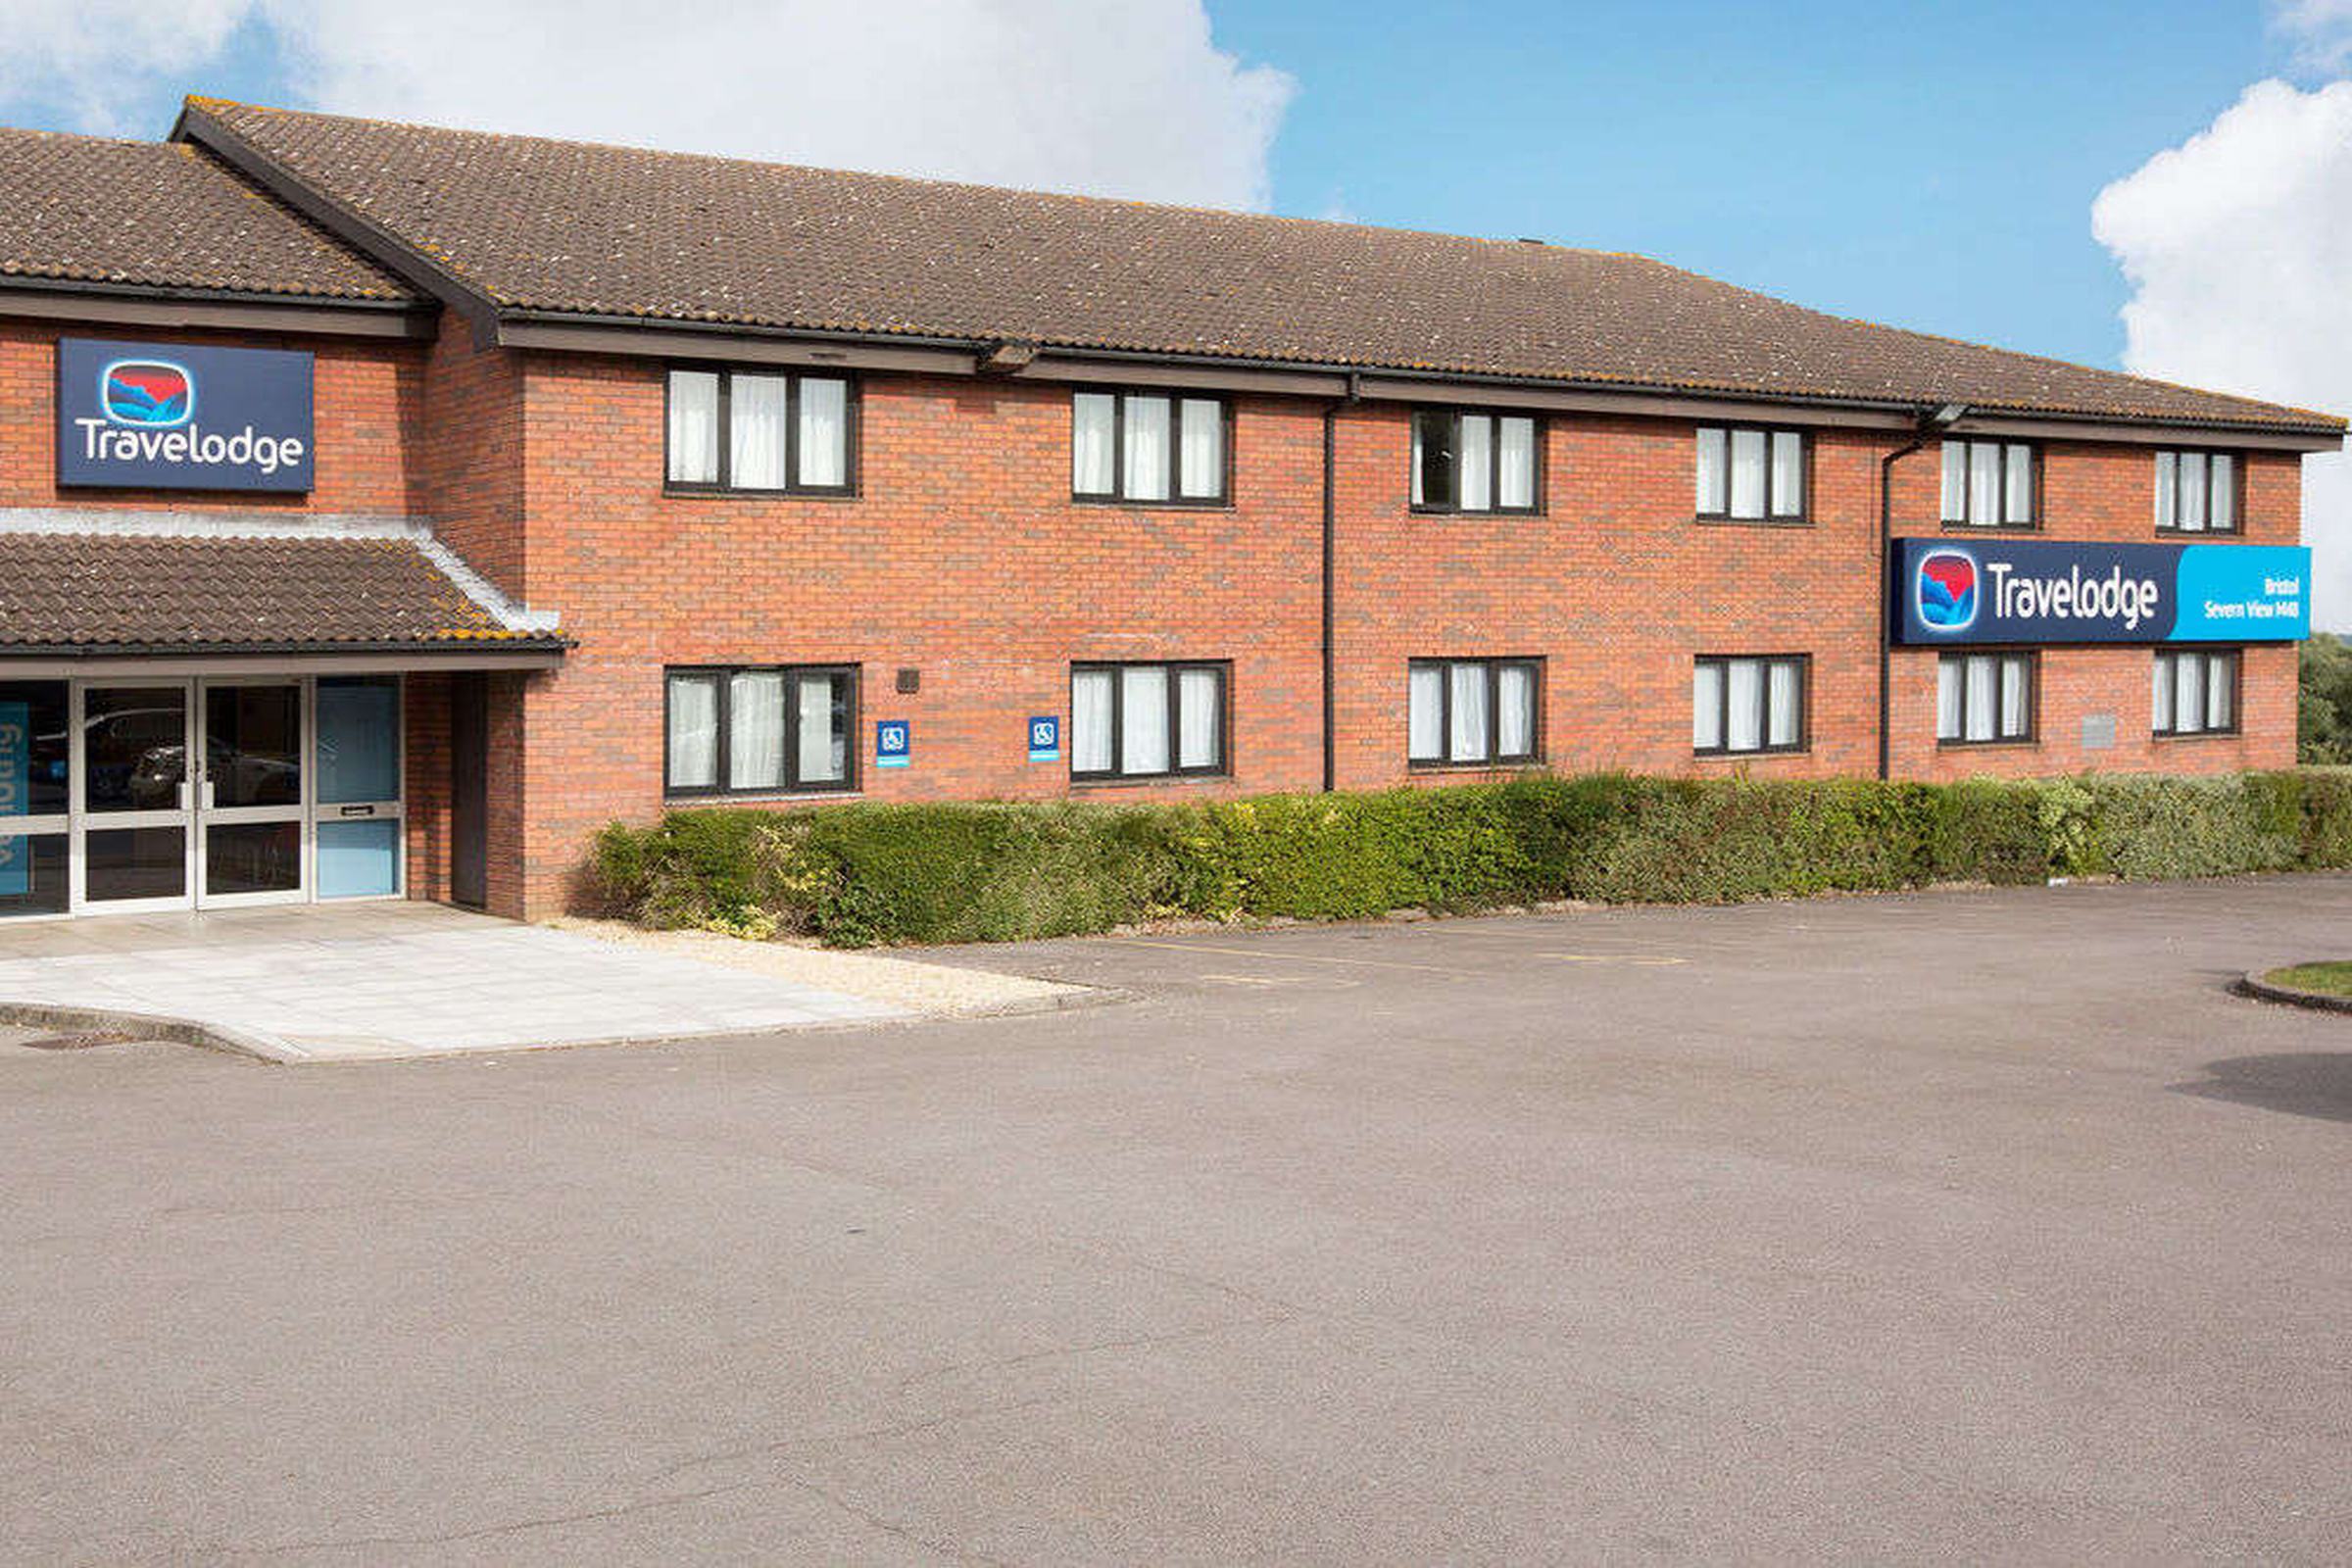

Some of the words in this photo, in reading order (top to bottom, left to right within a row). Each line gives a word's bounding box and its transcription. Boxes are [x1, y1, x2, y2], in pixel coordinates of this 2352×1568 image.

[74, 418, 304, 474] Travelodge
[1986, 564, 2158, 630] Travelodge
[2264, 576, 2299, 596] Bristol
[2203, 600, 2245, 619] Severn
[2246, 600, 2274, 619] View
